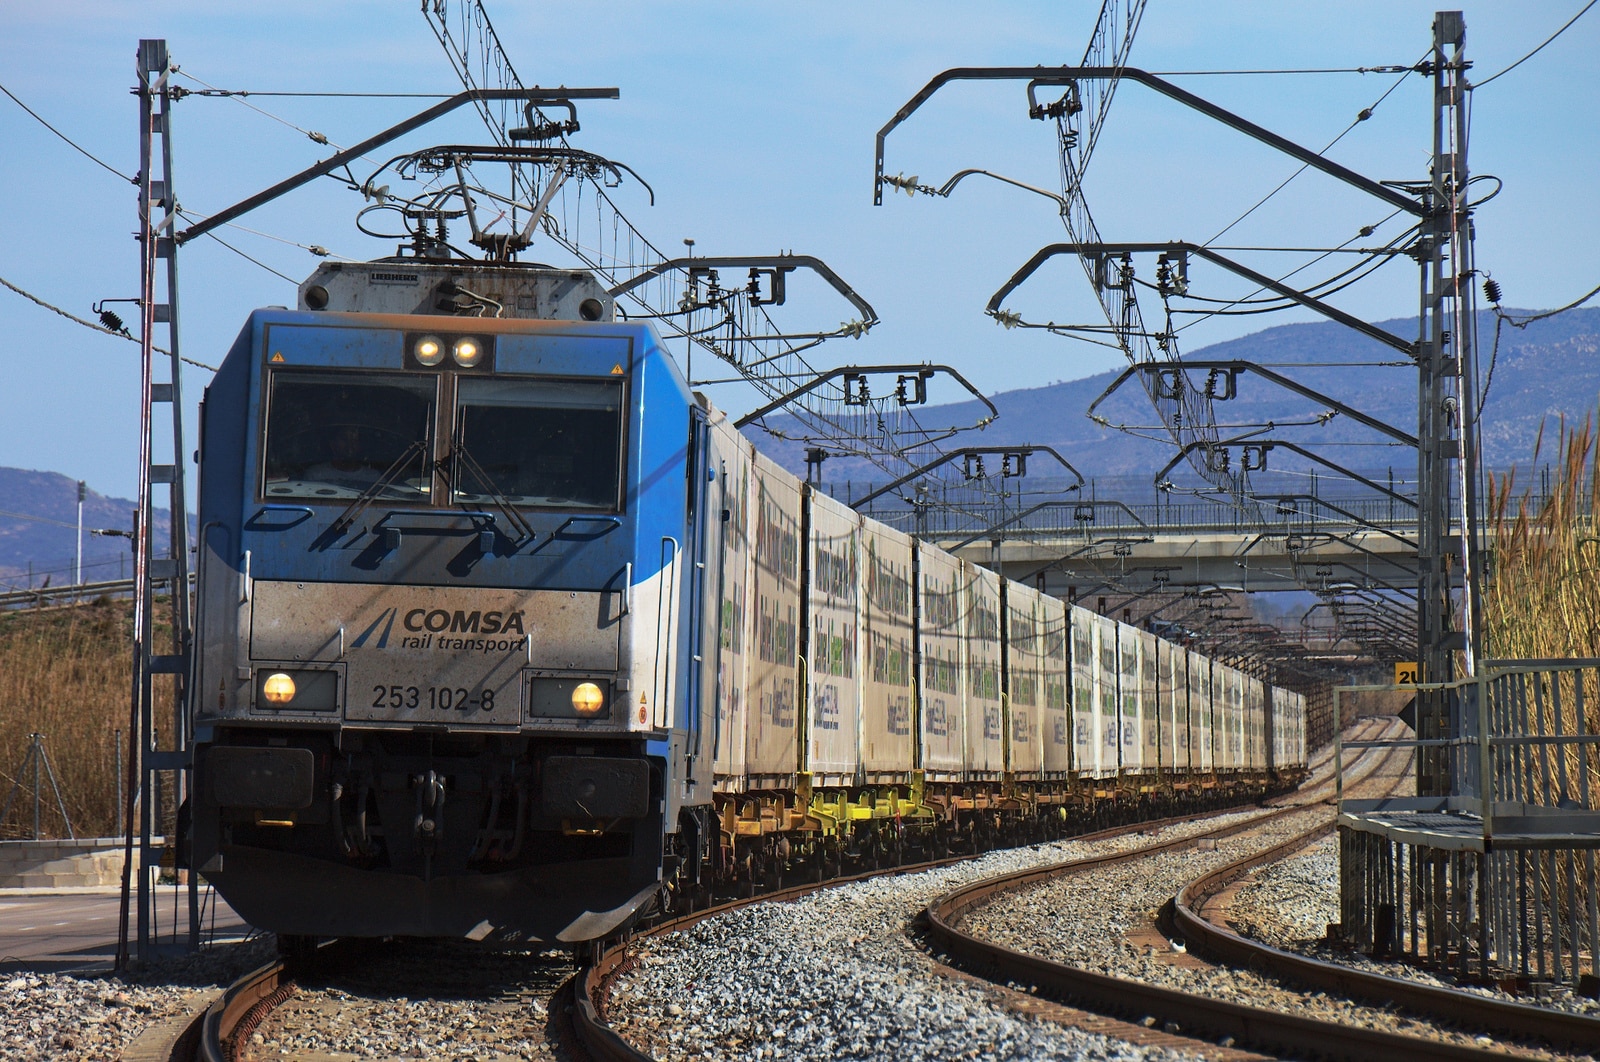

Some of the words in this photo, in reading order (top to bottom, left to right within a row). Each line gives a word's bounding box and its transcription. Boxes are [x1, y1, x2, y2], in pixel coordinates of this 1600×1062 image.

[371, 273, 418, 281] LIEBHERR
[403, 608, 524, 634] COMSA
[401, 634, 432, 648] rail
[438, 635, 525, 654] transport
[372, 685, 420, 709] 253
[428, 687, 495, 711] 102-8
